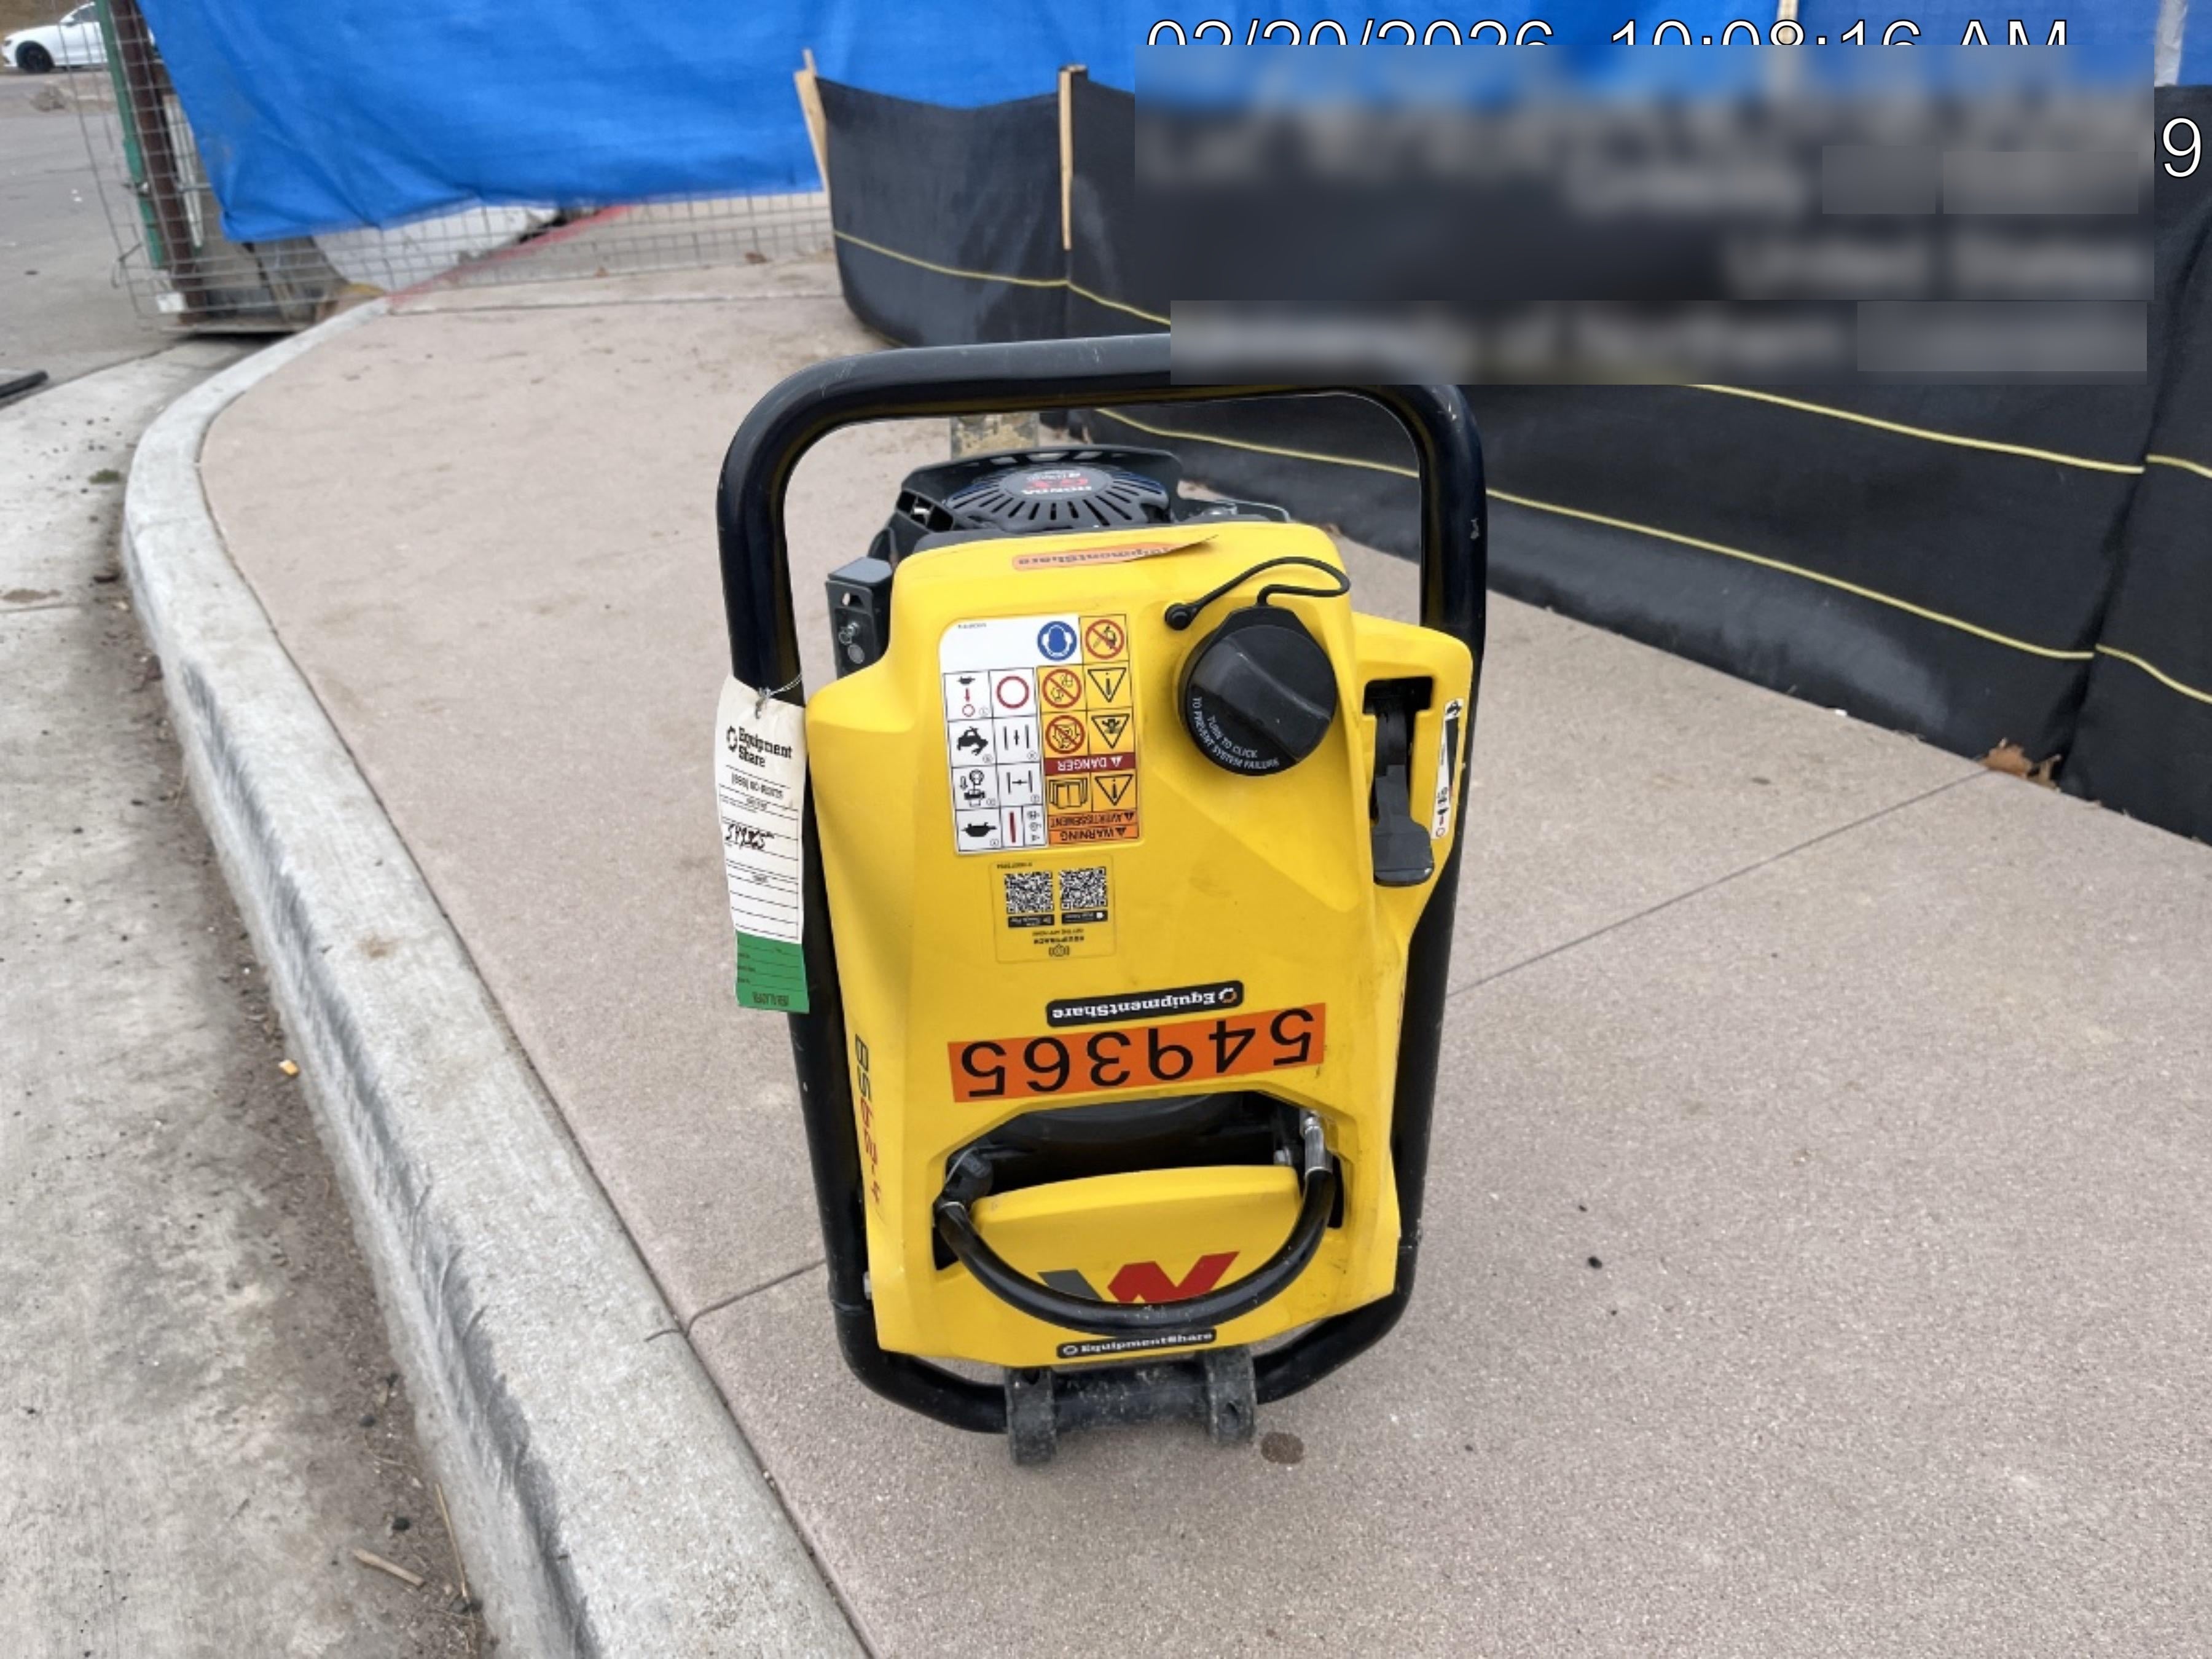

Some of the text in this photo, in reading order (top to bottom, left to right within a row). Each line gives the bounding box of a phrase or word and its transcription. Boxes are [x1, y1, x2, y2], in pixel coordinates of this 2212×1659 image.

[739, 726, 793, 759] Equipment
[739, 745, 766, 767] Share
[1057, 757, 1107, 771] DANGER
[1051, 812, 1123, 828] AVERTISSEMENT
[1060, 827, 1114, 841] WARNING
[1052, 991, 1215, 1019] EquipmentShare
[961, 1008, 1314, 1097] 549365
[1081, 1333, 1213, 1352] EquipmentShare
